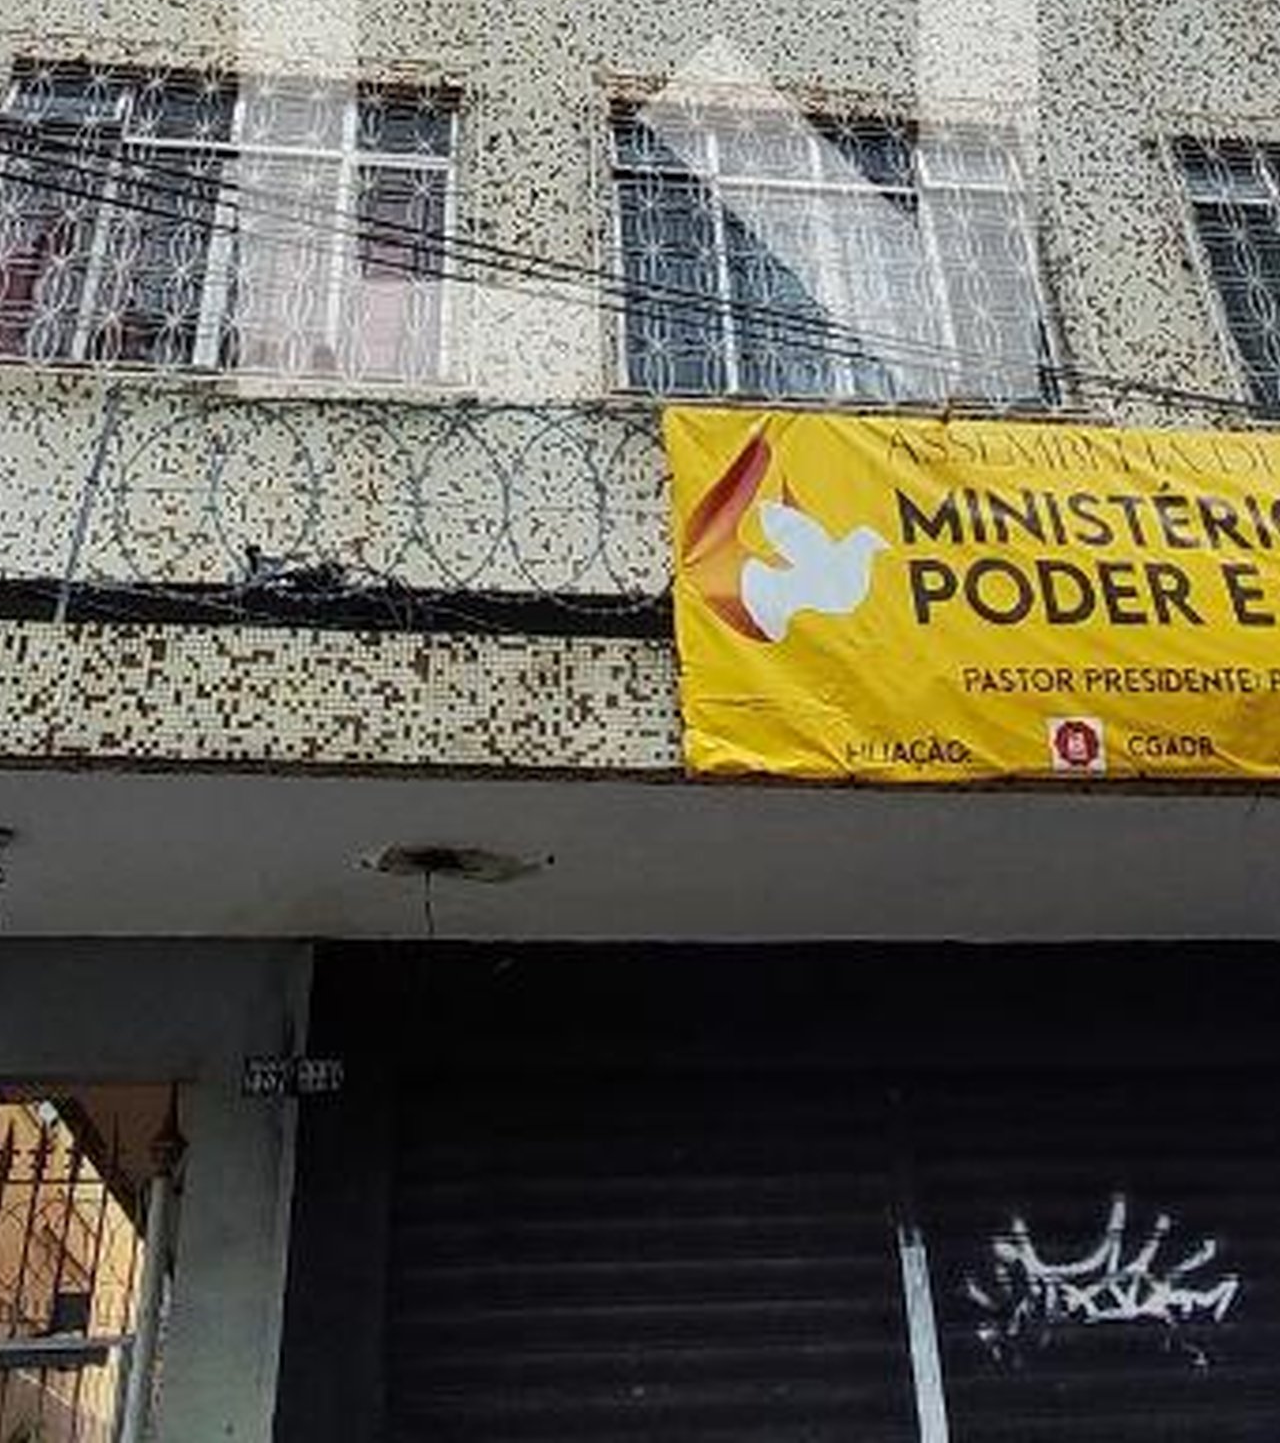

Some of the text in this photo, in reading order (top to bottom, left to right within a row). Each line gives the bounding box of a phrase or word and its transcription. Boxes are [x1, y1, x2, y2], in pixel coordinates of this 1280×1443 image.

[907, 558, 1204, 626] PODER
[1221, 563, 1276, 626] E
[963, 667, 1074, 693] PASTOR
